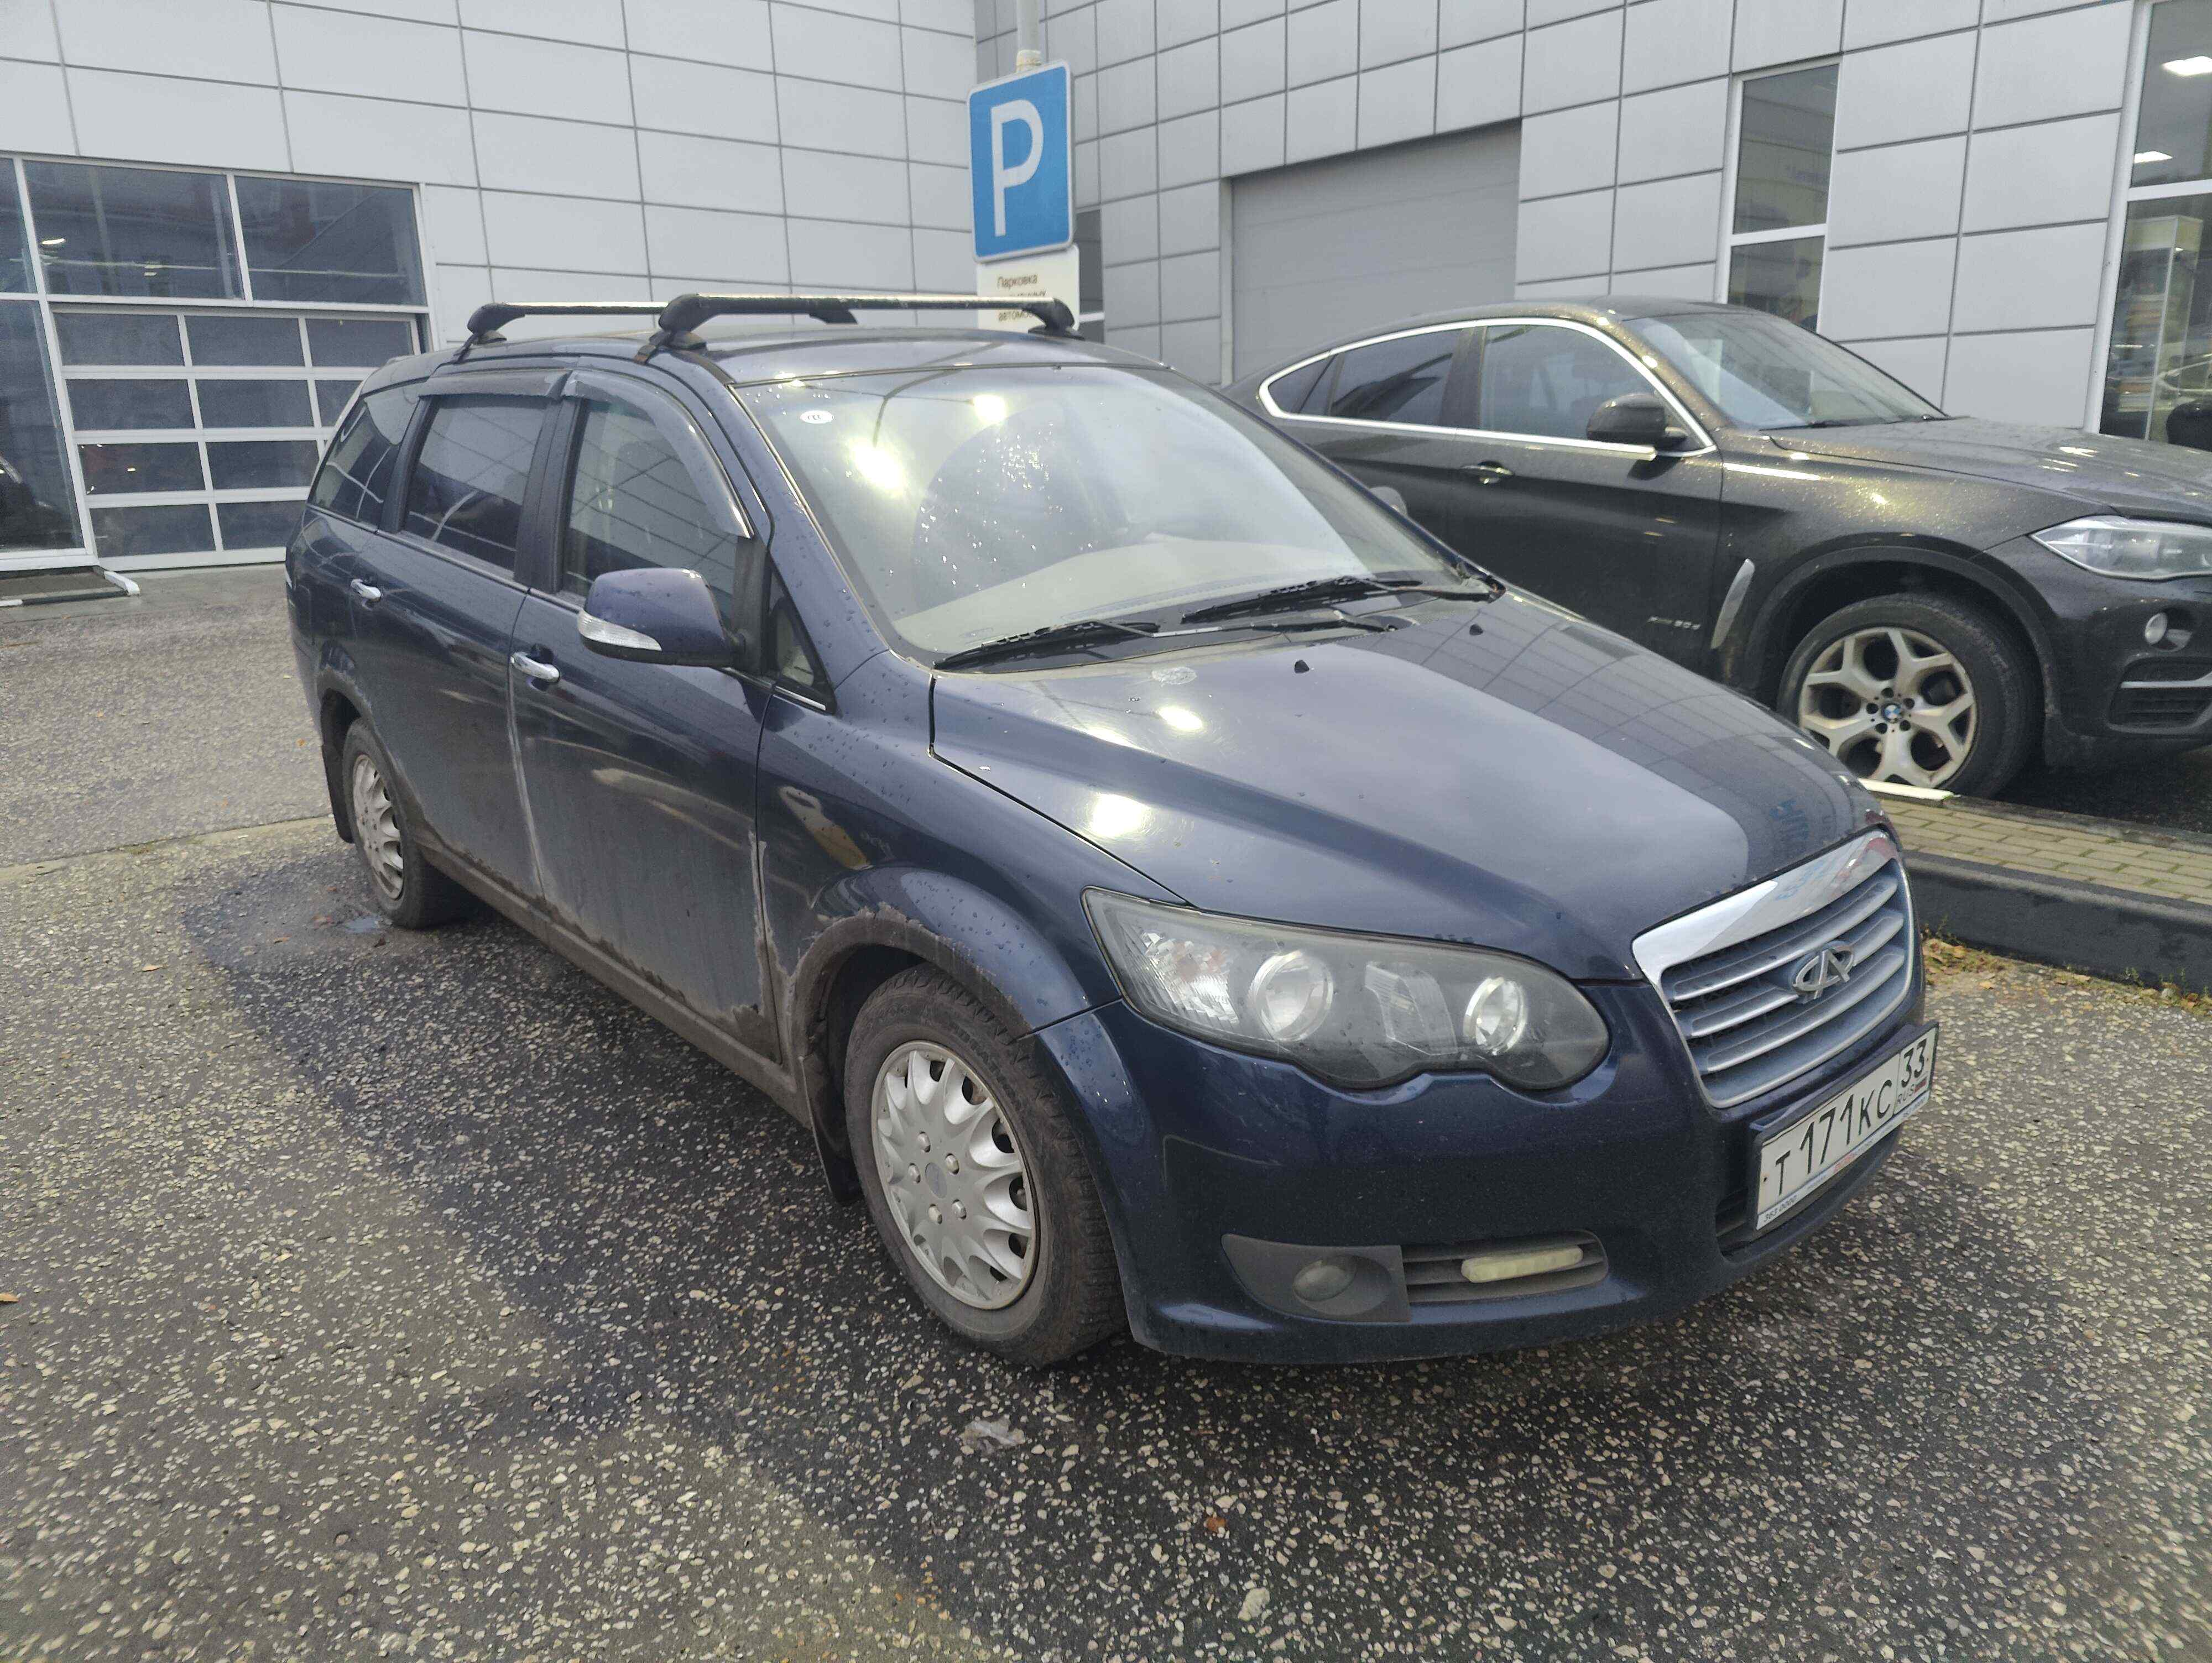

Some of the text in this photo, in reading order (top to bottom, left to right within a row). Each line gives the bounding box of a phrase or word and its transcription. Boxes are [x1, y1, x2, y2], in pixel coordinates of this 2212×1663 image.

[990, 100, 1044, 237] P
[998, 275, 1037, 290] Парковка
[1901, 1038, 1927, 1088] 33
[1897, 1084, 1914, 1104] RUS
